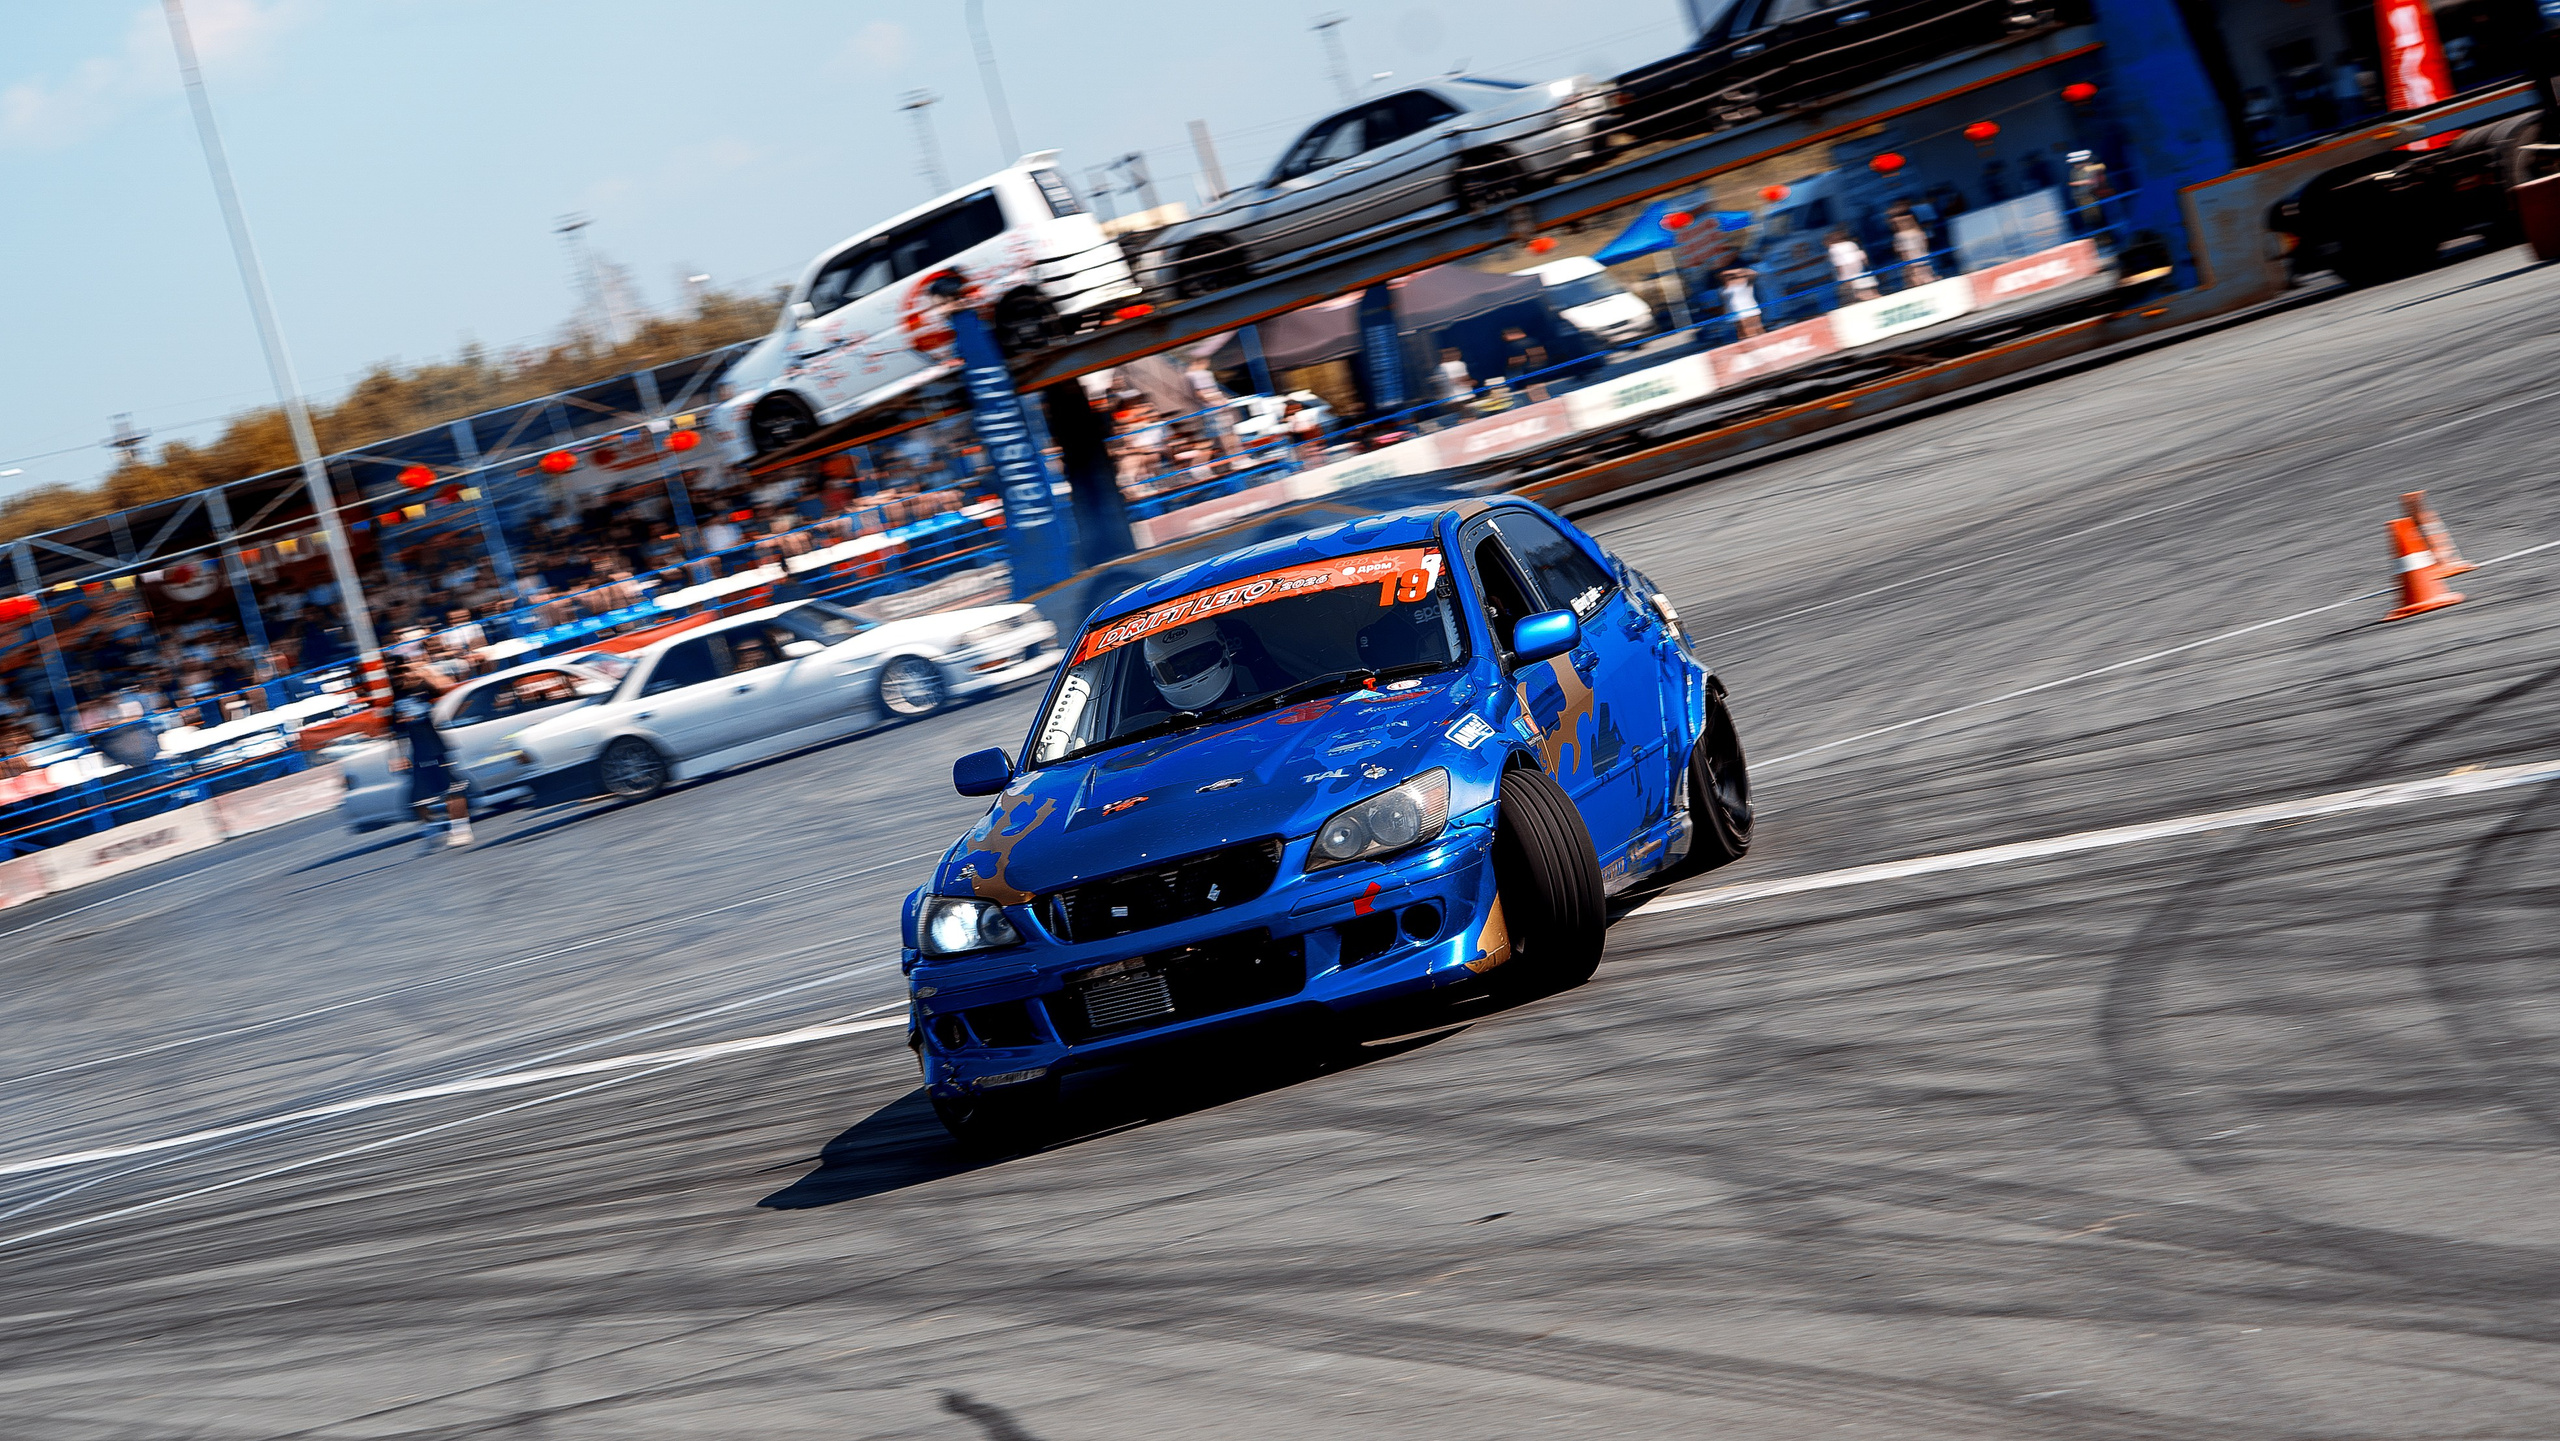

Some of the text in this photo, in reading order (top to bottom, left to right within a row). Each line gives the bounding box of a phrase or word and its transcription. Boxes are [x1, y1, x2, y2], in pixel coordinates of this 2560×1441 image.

[1097, 600, 1195, 649] DRIFT
[1190, 579, 1274, 616] LETO
[1378, 568, 1430, 607] 19
